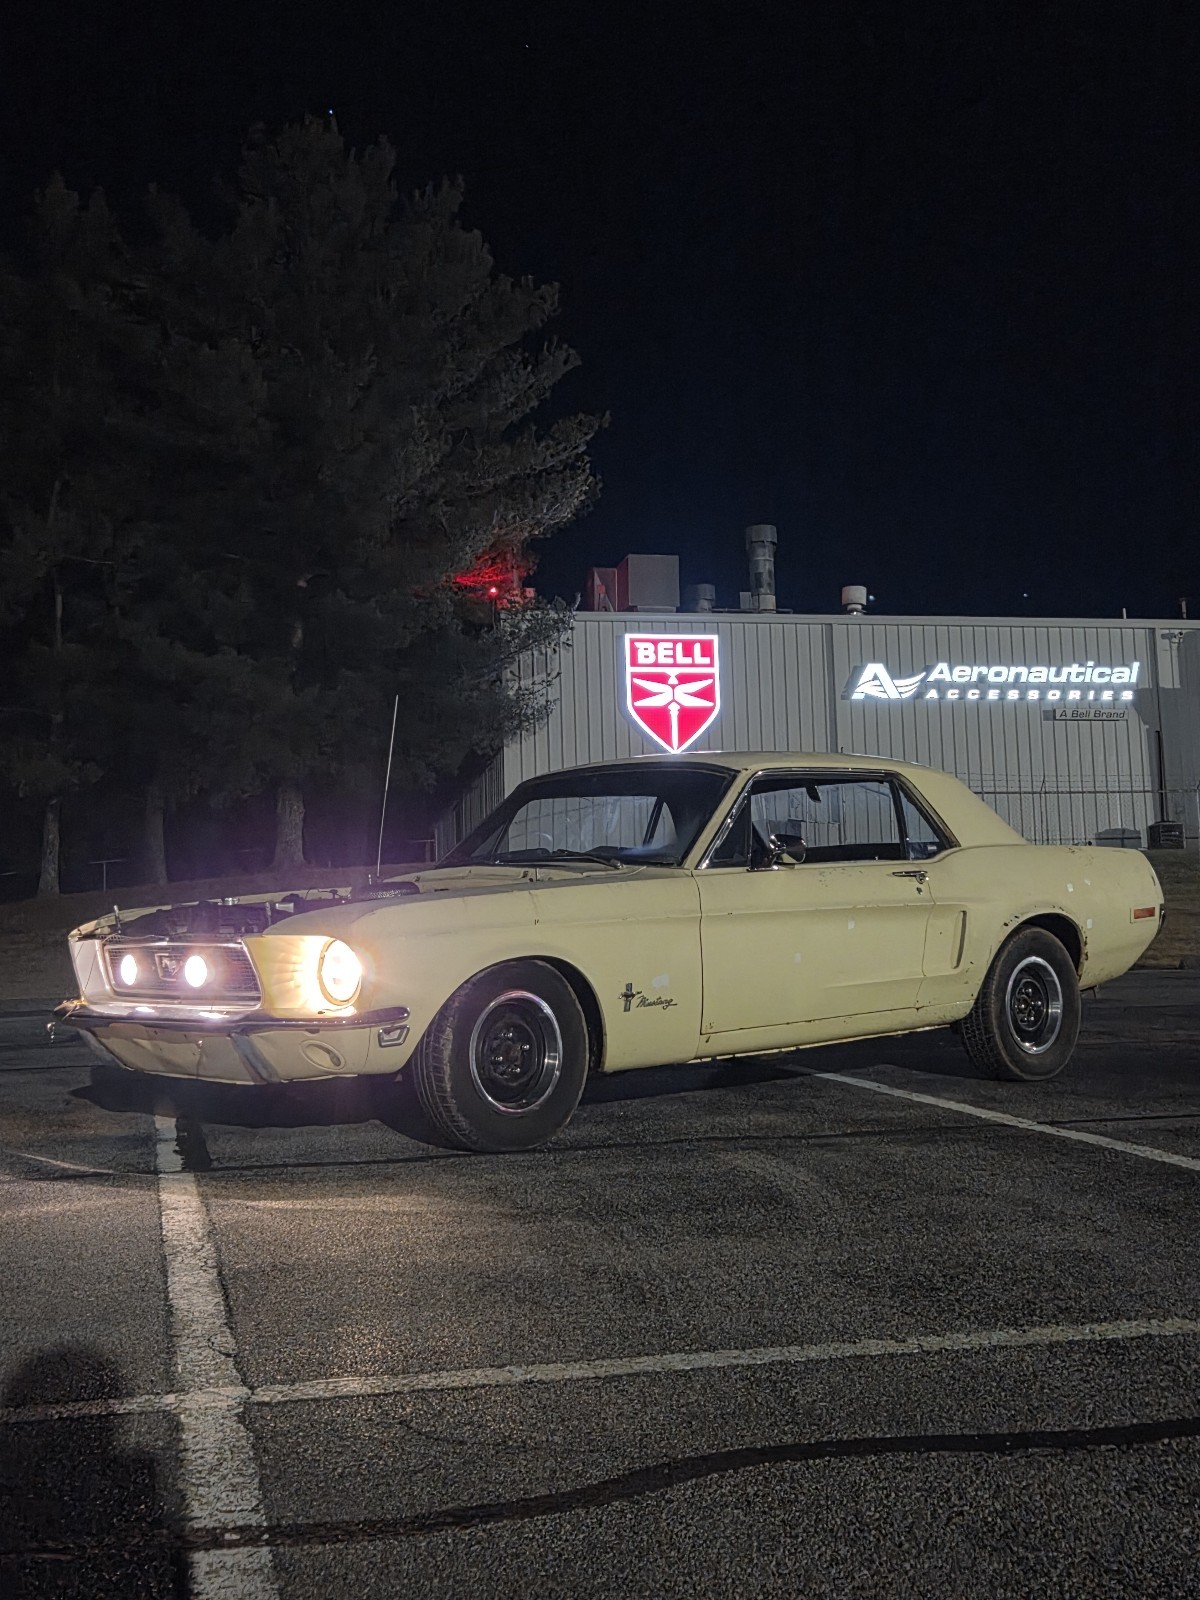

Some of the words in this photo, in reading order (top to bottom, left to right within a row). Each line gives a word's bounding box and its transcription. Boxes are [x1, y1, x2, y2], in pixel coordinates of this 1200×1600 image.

[633, 641, 711, 665] BELL
[926, 661, 1140, 683] Aeronautical
[925, 688, 1134, 700] ACCESSORIES
[1059, 709, 1068, 719] A
[1071, 709, 1091, 719] Bell
[1093, 709, 1126, 719] Brand
[636, 994, 678, 1010] Mustang
